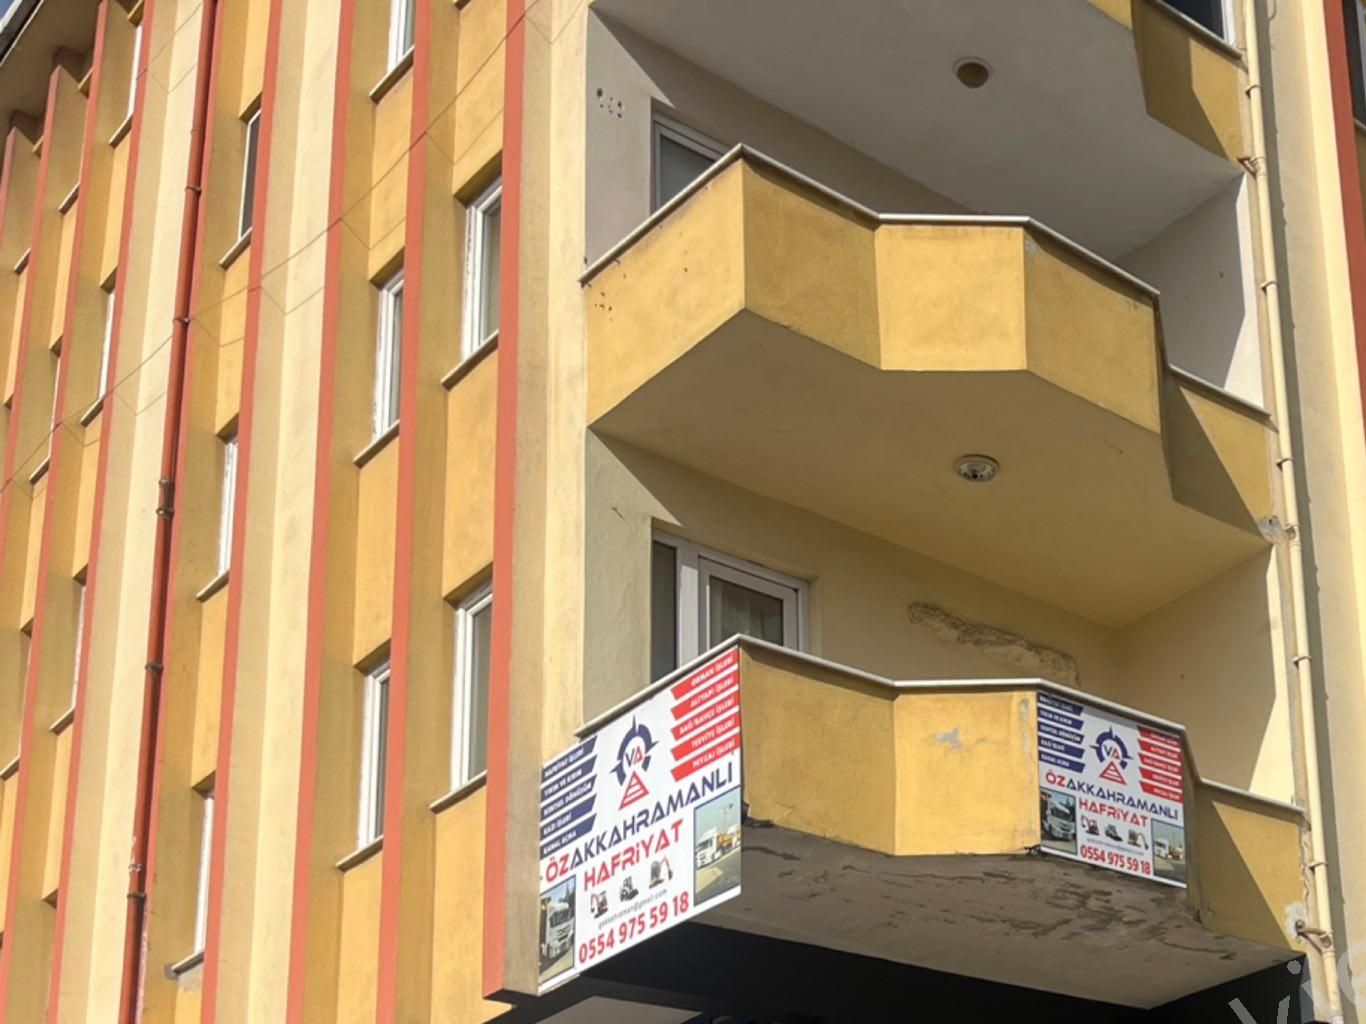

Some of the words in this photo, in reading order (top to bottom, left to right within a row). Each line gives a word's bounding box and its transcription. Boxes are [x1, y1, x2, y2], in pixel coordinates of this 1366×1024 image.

[546, 762, 734, 883] ÖZAKKAHRAMANLI
[1046, 770, 1178, 820] ÖZAKKAHRAMANLI
[1079, 797, 1149, 827] HAFRİYAT
[584, 818, 684, 892] HAFRİYAT
[1081, 844, 1106, 863] 0554
[1107, 852, 1125, 869] 975
[1126, 857, 1139, 872] 59
[1140, 861, 1151, 875] 18
[579, 927, 615, 964] 0554
[619, 912, 646, 944] 975
[649, 901, 668, 930] 59
[673, 891, 689, 917] 18
